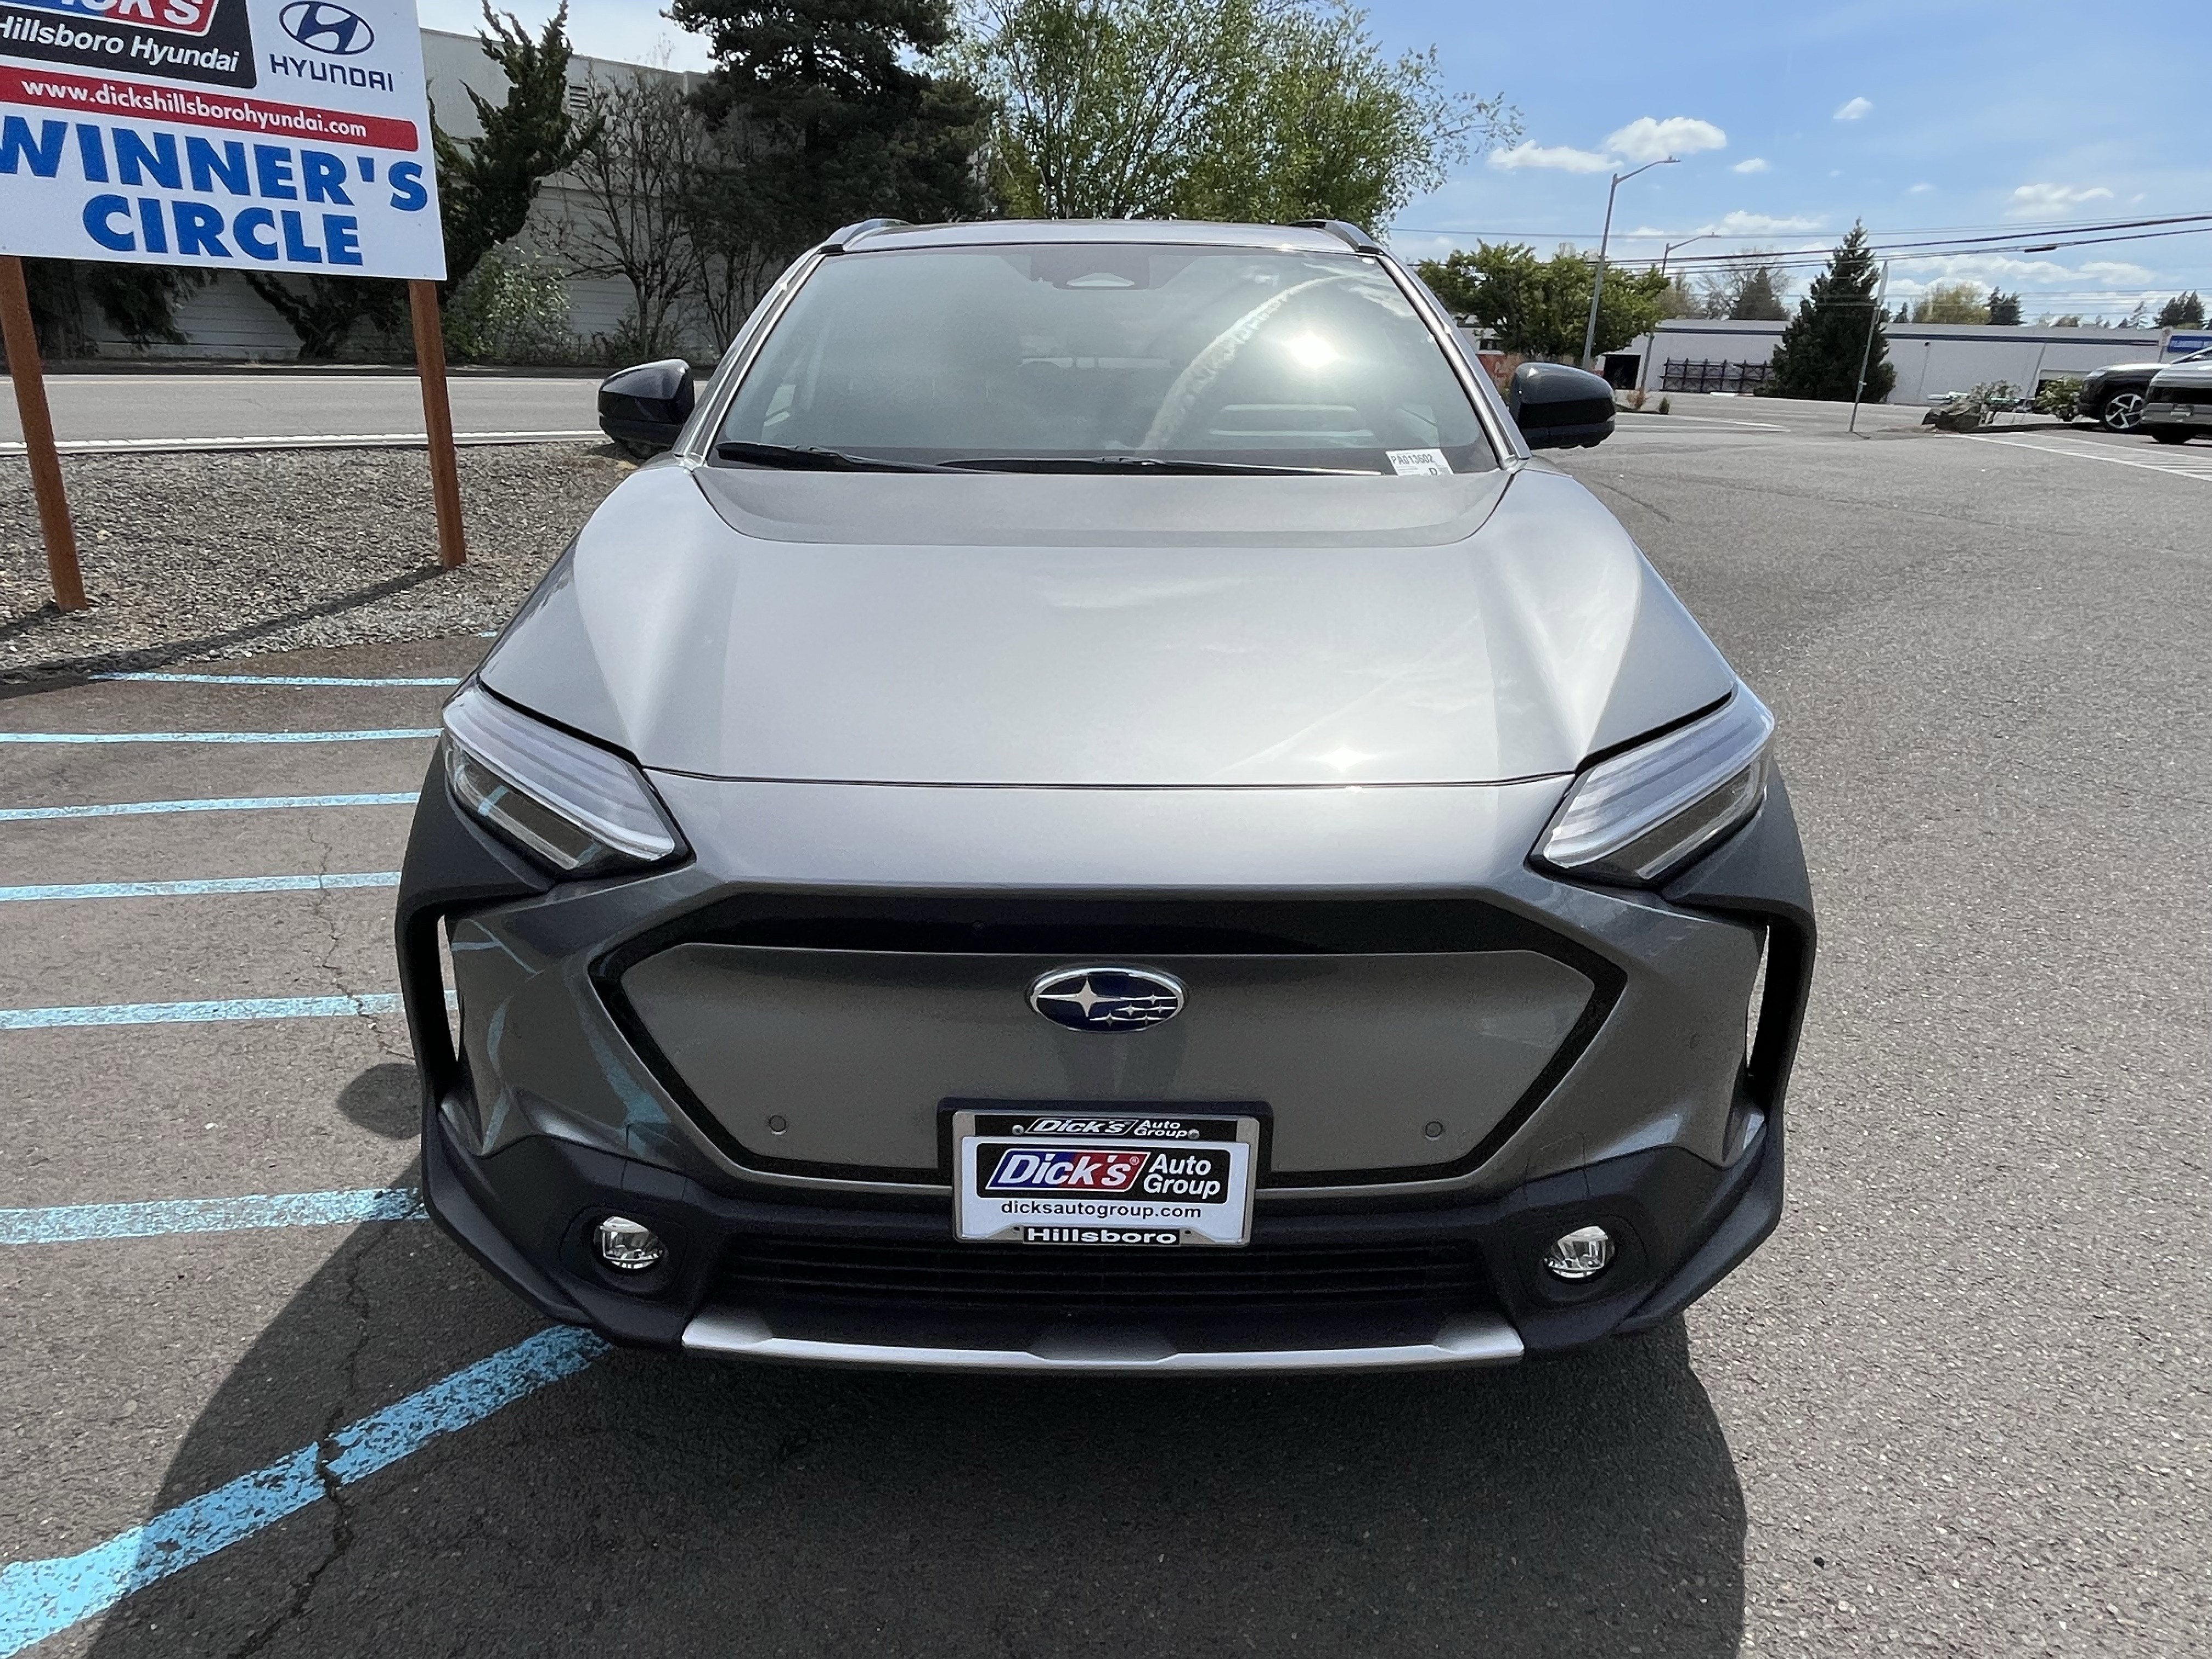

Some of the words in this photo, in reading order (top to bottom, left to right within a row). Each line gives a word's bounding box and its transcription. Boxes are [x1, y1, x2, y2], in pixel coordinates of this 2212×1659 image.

[130, 36, 239, 72] Hyundai
[269, 54, 394, 92] HYUNDAI
[21, 80, 366, 137] www.dickshillsborohyundai.com
[0, 115, 428, 212] WINNER'S
[82, 194, 363, 266] CIRCLE
[1134, 1128, 1187, 1138] Group
[1140, 1120, 1181, 1129] Auto
[1149, 1153, 1211, 1175] Auto
[1143, 1174, 1221, 1199] Group
[1001, 1201, 1201, 1218] dicksautogroup.com
[1028, 1228, 1177, 1244] Hillsboro
